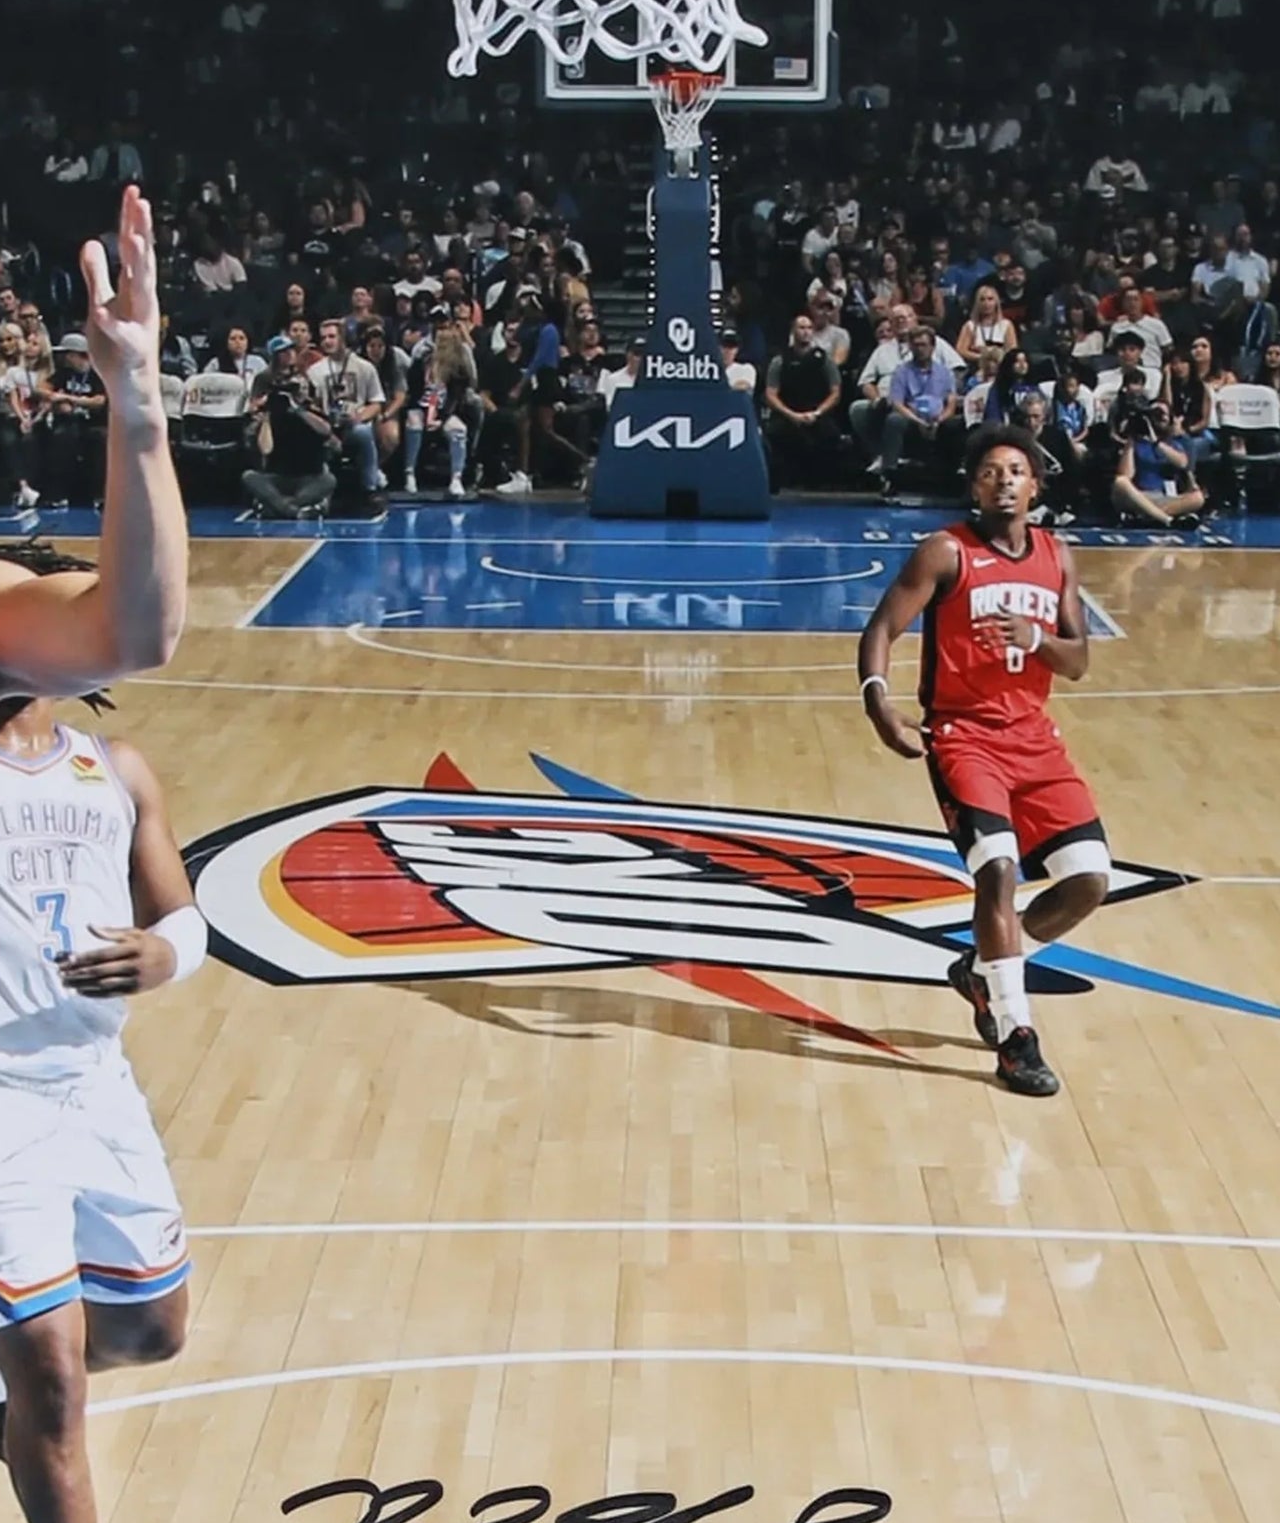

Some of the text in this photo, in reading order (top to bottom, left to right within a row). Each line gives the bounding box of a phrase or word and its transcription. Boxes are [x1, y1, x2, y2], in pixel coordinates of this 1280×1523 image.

[668, 317, 695, 352] OU
[646, 354, 719, 380] Health
[614, 415, 746, 450] KIA
[9, 847, 77, 884] CITY
[33, 890, 74, 965] 3
